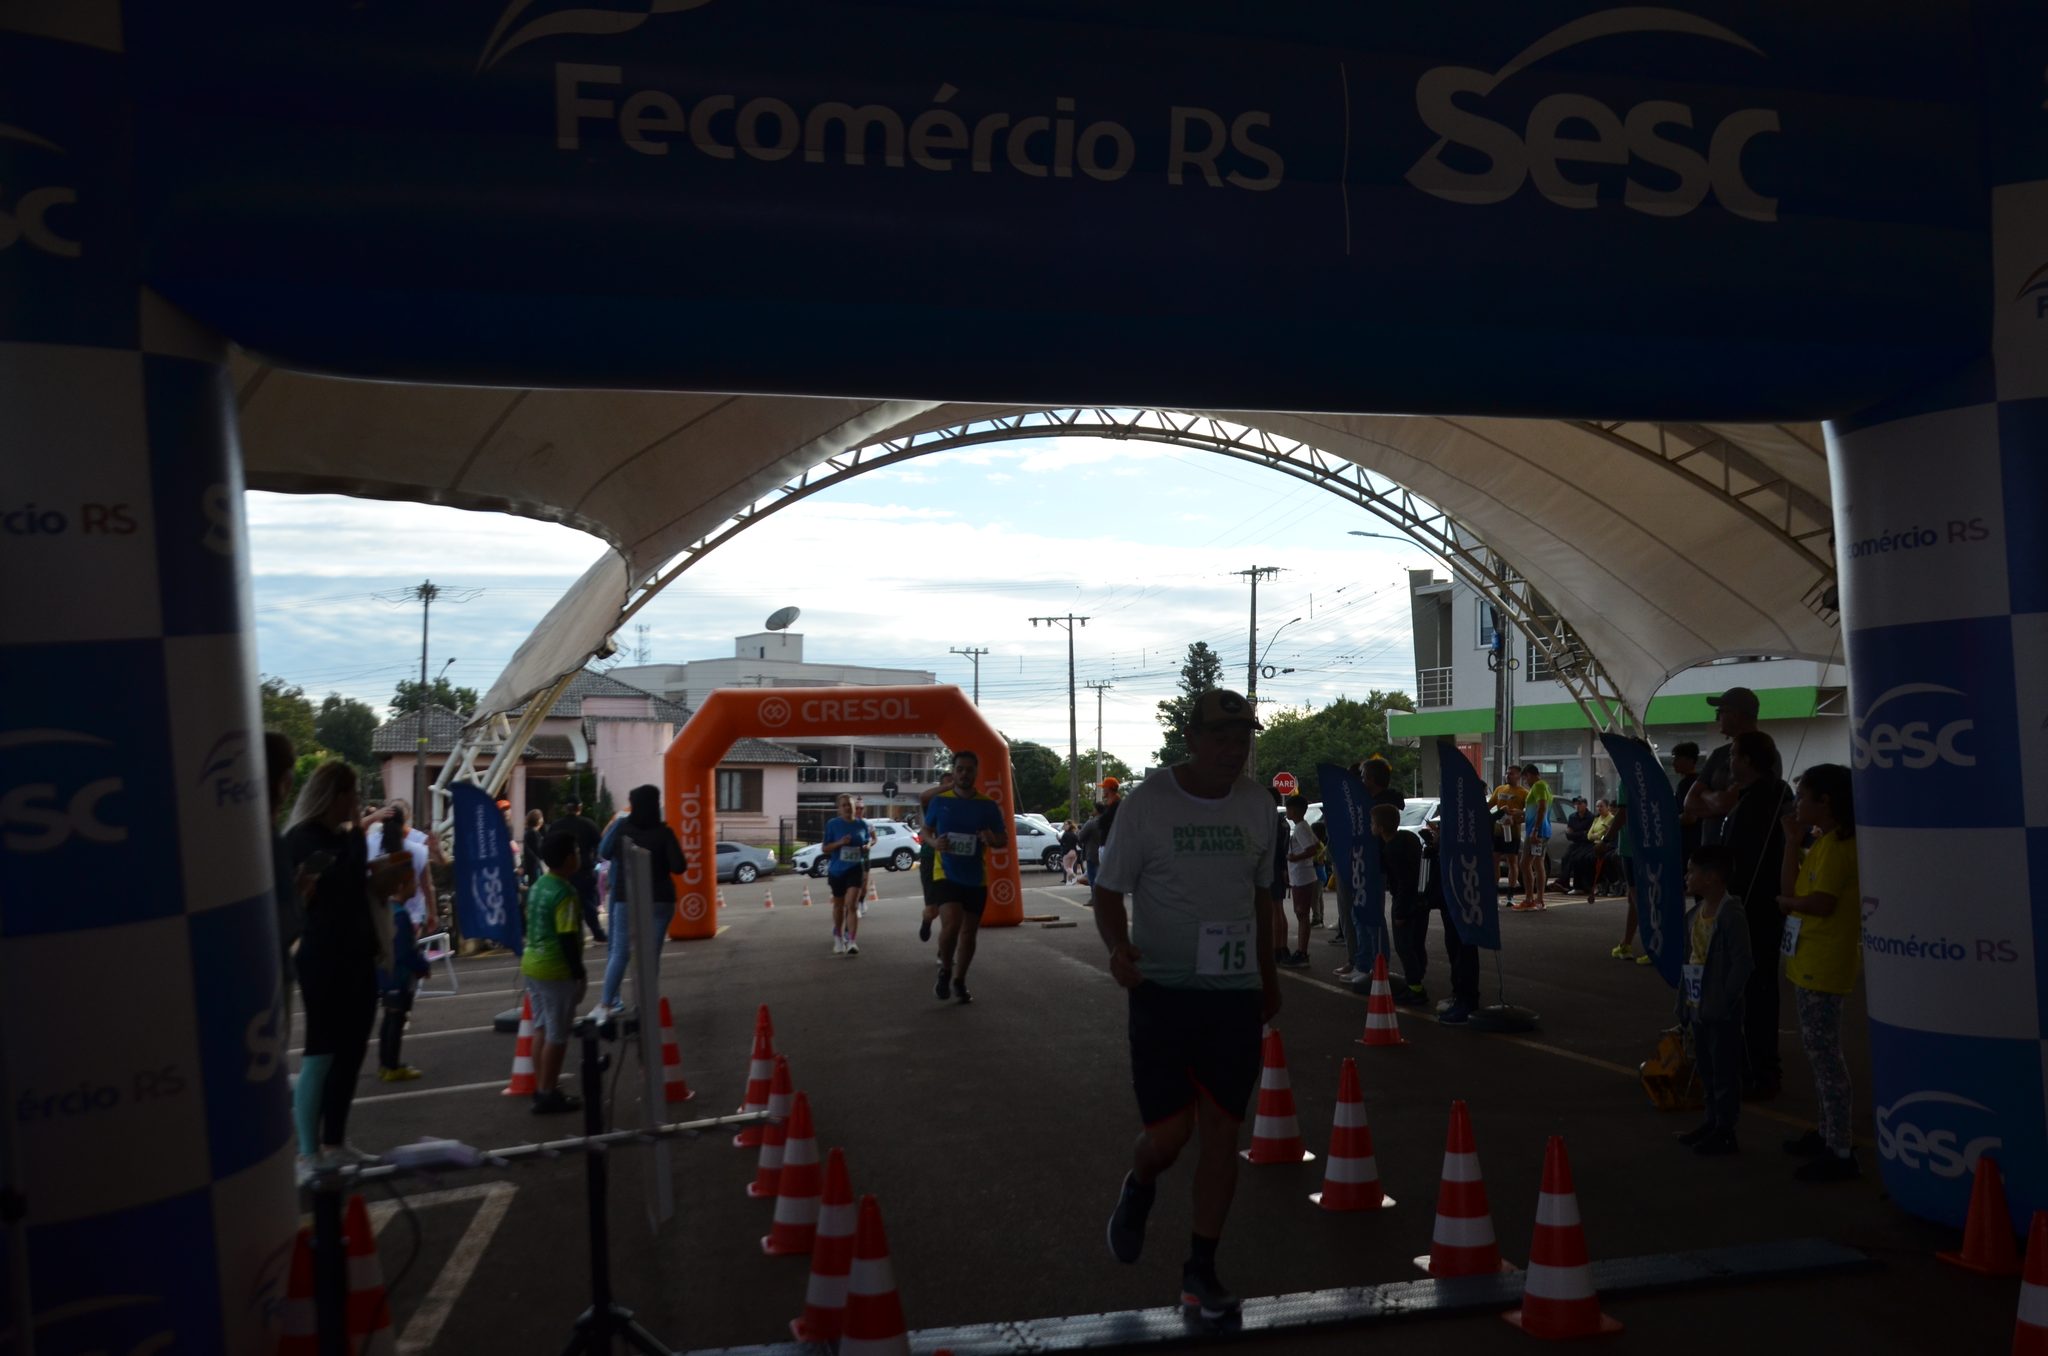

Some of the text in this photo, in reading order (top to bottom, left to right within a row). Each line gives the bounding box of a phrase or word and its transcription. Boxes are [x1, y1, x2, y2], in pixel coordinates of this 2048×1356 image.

[554, 61, 1286, 191] Fecomércio RS
[1402, 65, 1781, 222] Sesc
[81, 502, 139, 535] RS
[1947, 517, 1990, 544] RS
[801, 697, 920, 722] CRESOL
[1274, 780, 1294, 788] PARE
[1173, 822, 1243, 838] RÚSTICA
[1199, 838, 1245, 851] ANOS
[482, 865, 507, 926] Sesc
[1460, 853, 1484, 927] Sesc
[1218, 940, 1246, 970] 15
[1975, 938, 2019, 963] RS
[133, 1064, 187, 1104] RS
